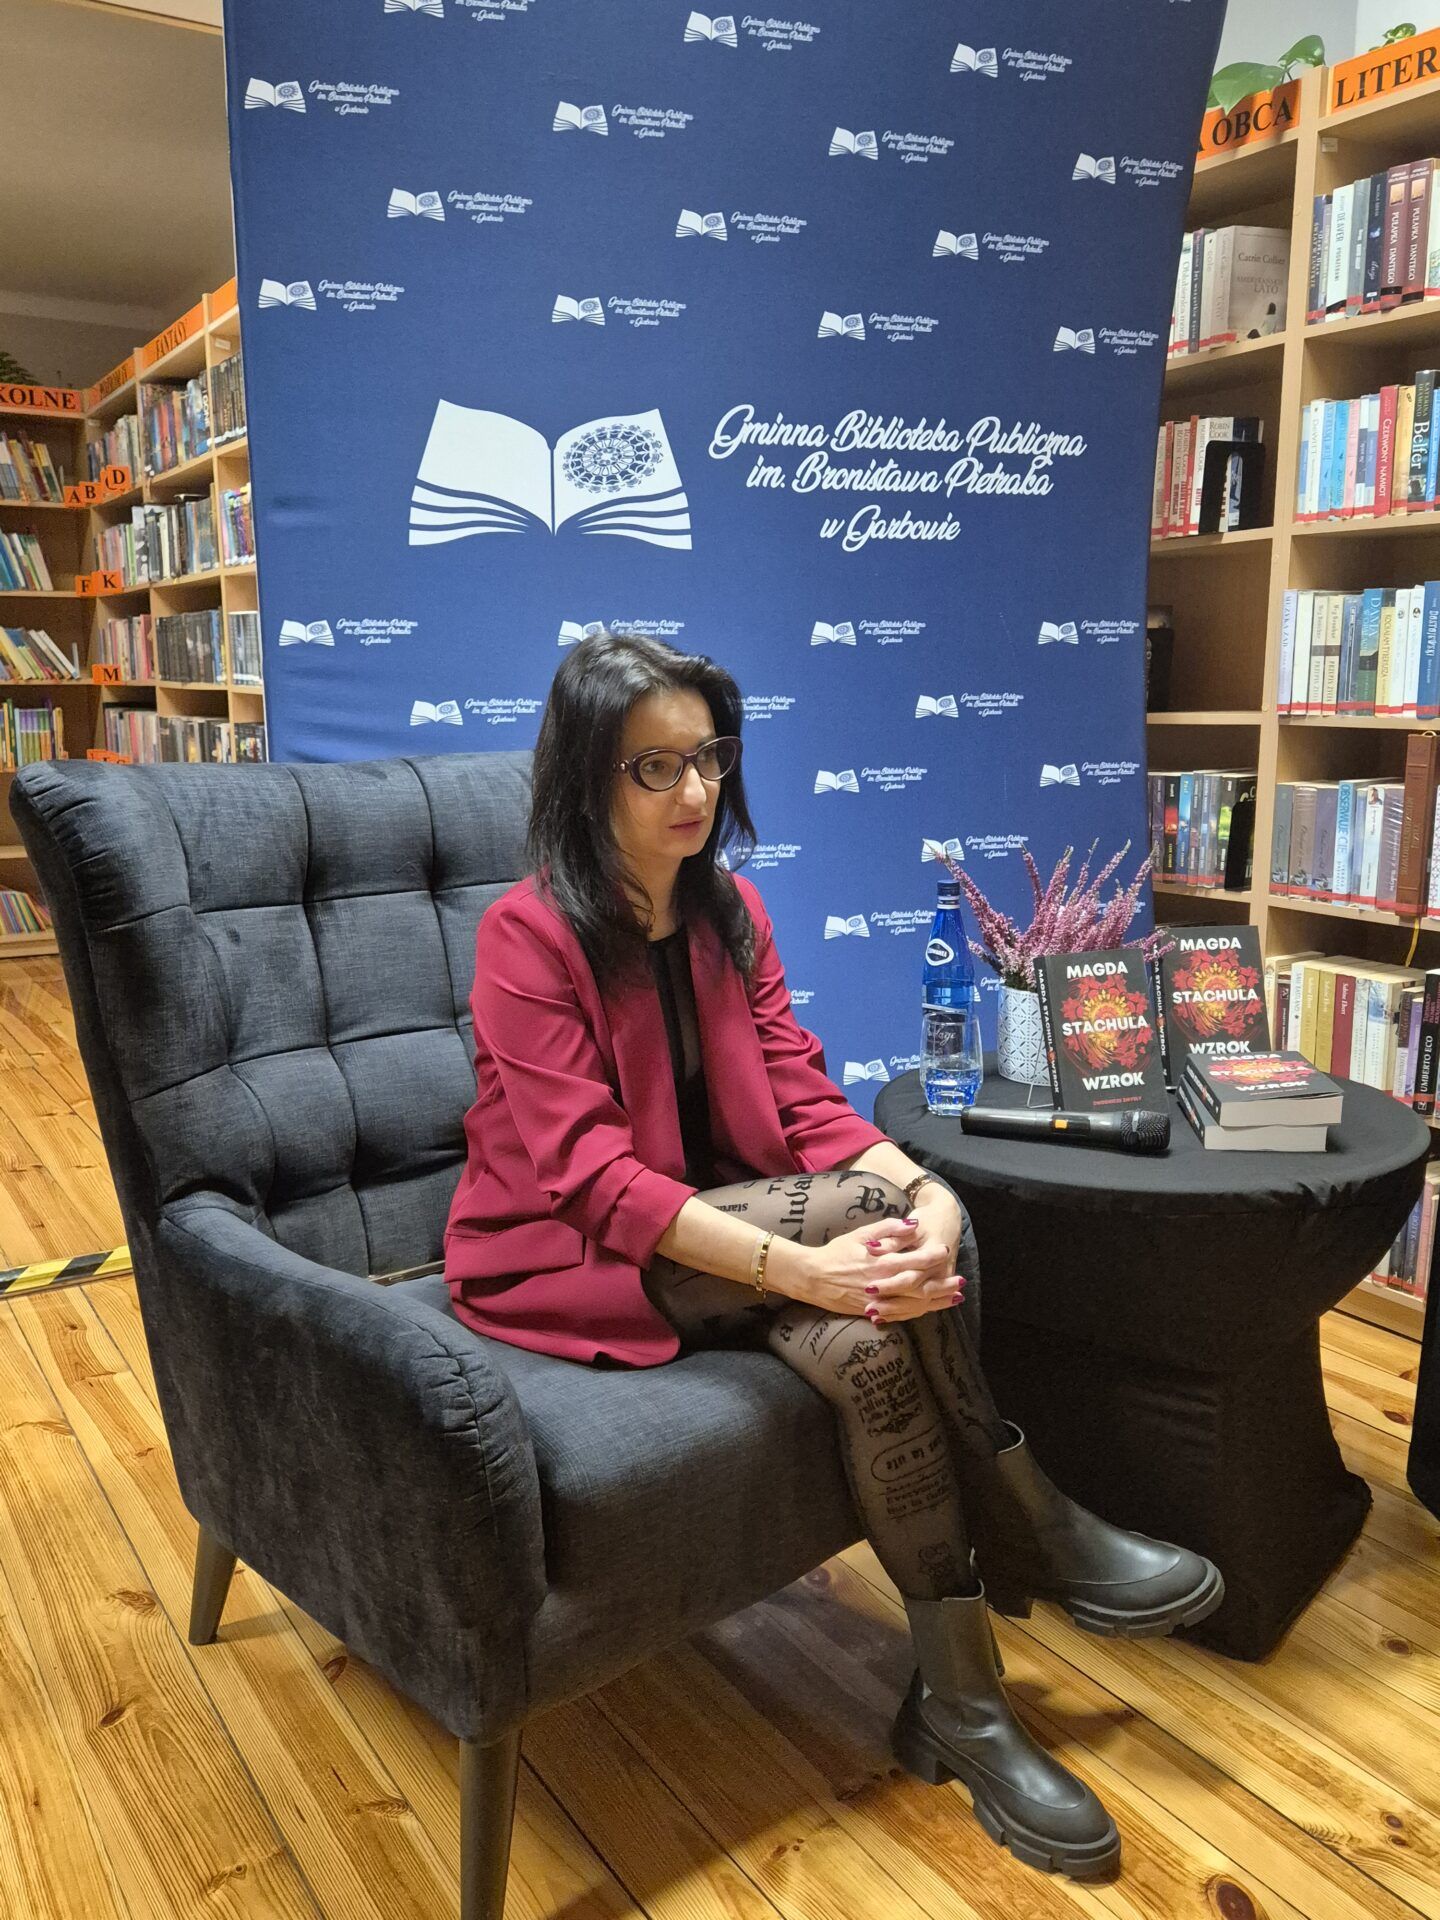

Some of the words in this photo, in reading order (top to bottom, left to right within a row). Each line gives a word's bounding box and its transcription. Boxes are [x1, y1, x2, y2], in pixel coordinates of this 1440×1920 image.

[1212, 97, 1293, 146] OBCA
[1335, 212, 1346, 243] DEAVER
[1387, 248, 1397, 284] DANTEGO
[1408, 244, 1418, 281] DANTEGO
[708, 404, 828, 459] Gminna
[831, 409, 963, 453] Biblioteka
[966, 417, 1087, 470] Publiczna
[1411, 420, 1430, 470] Belfer
[113, 470, 125, 484] D
[746, 455, 786, 488] im.
[945, 457, 1055, 498] Pietraka
[1378, 466, 1388, 497] NAMIOT
[69, 489, 82, 503] A
[85, 486, 96, 499] B
[820, 515, 844, 540] w
[841, 504, 961, 552] Garbowie
[80, 580, 90, 592] F
[103, 574, 117, 588] K
[1368, 597, 1381, 637] DAMA
[103, 668, 119, 680] M
[1180, 937, 1242, 951] MAGDA
[1066, 961, 1129, 979] MAGDA
[1037, 968, 1048, 1004] MAGDA
[1153, 974, 1164, 1018] STACHULA
[1172, 988, 1259, 1005] STACHULA
[1341, 982, 1349, 1000] Sabine
[1042, 1005, 1055, 1053] STACHULA
[1061, 1015, 1149, 1036] STACHULA
[1158, 1025, 1166, 1056] WZROK
[1189, 1040, 1251, 1055] WZROK
[1423, 1036, 1433, 1053] ECO
[1211, 1053, 1282, 1061] MAGDA
[1050, 1059, 1060, 1093] WZROK
[1082, 1072, 1145, 1091] WZROK
[1208, 1066, 1313, 1077] STACHULA
[1420, 1054, 1432, 1092] UMBERTO
[1236, 1080, 1309, 1092] WZROK
